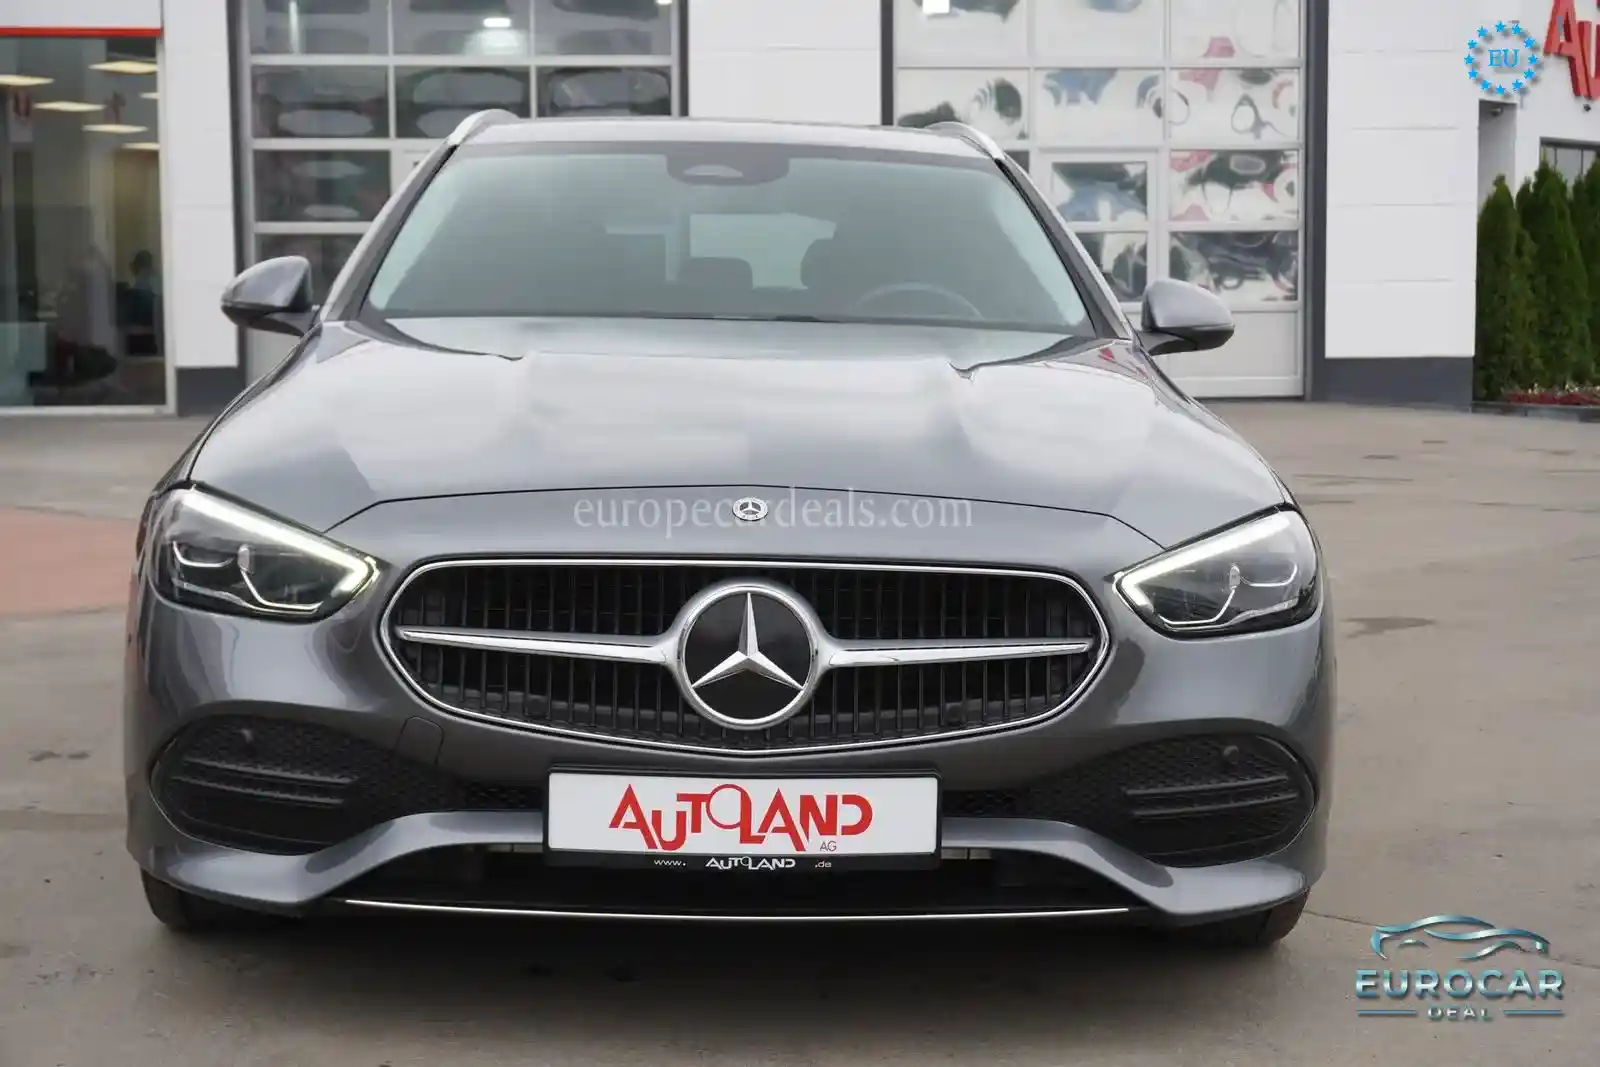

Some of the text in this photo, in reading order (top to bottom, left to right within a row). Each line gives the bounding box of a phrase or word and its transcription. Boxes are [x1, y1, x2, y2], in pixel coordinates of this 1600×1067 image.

[1543, 0, 1600, 99] AU
[609, 783, 872, 851] AUTOLAND
[653, 857, 832, 870] www. AUTOLAND .de
[819, 841, 837, 852] AG
